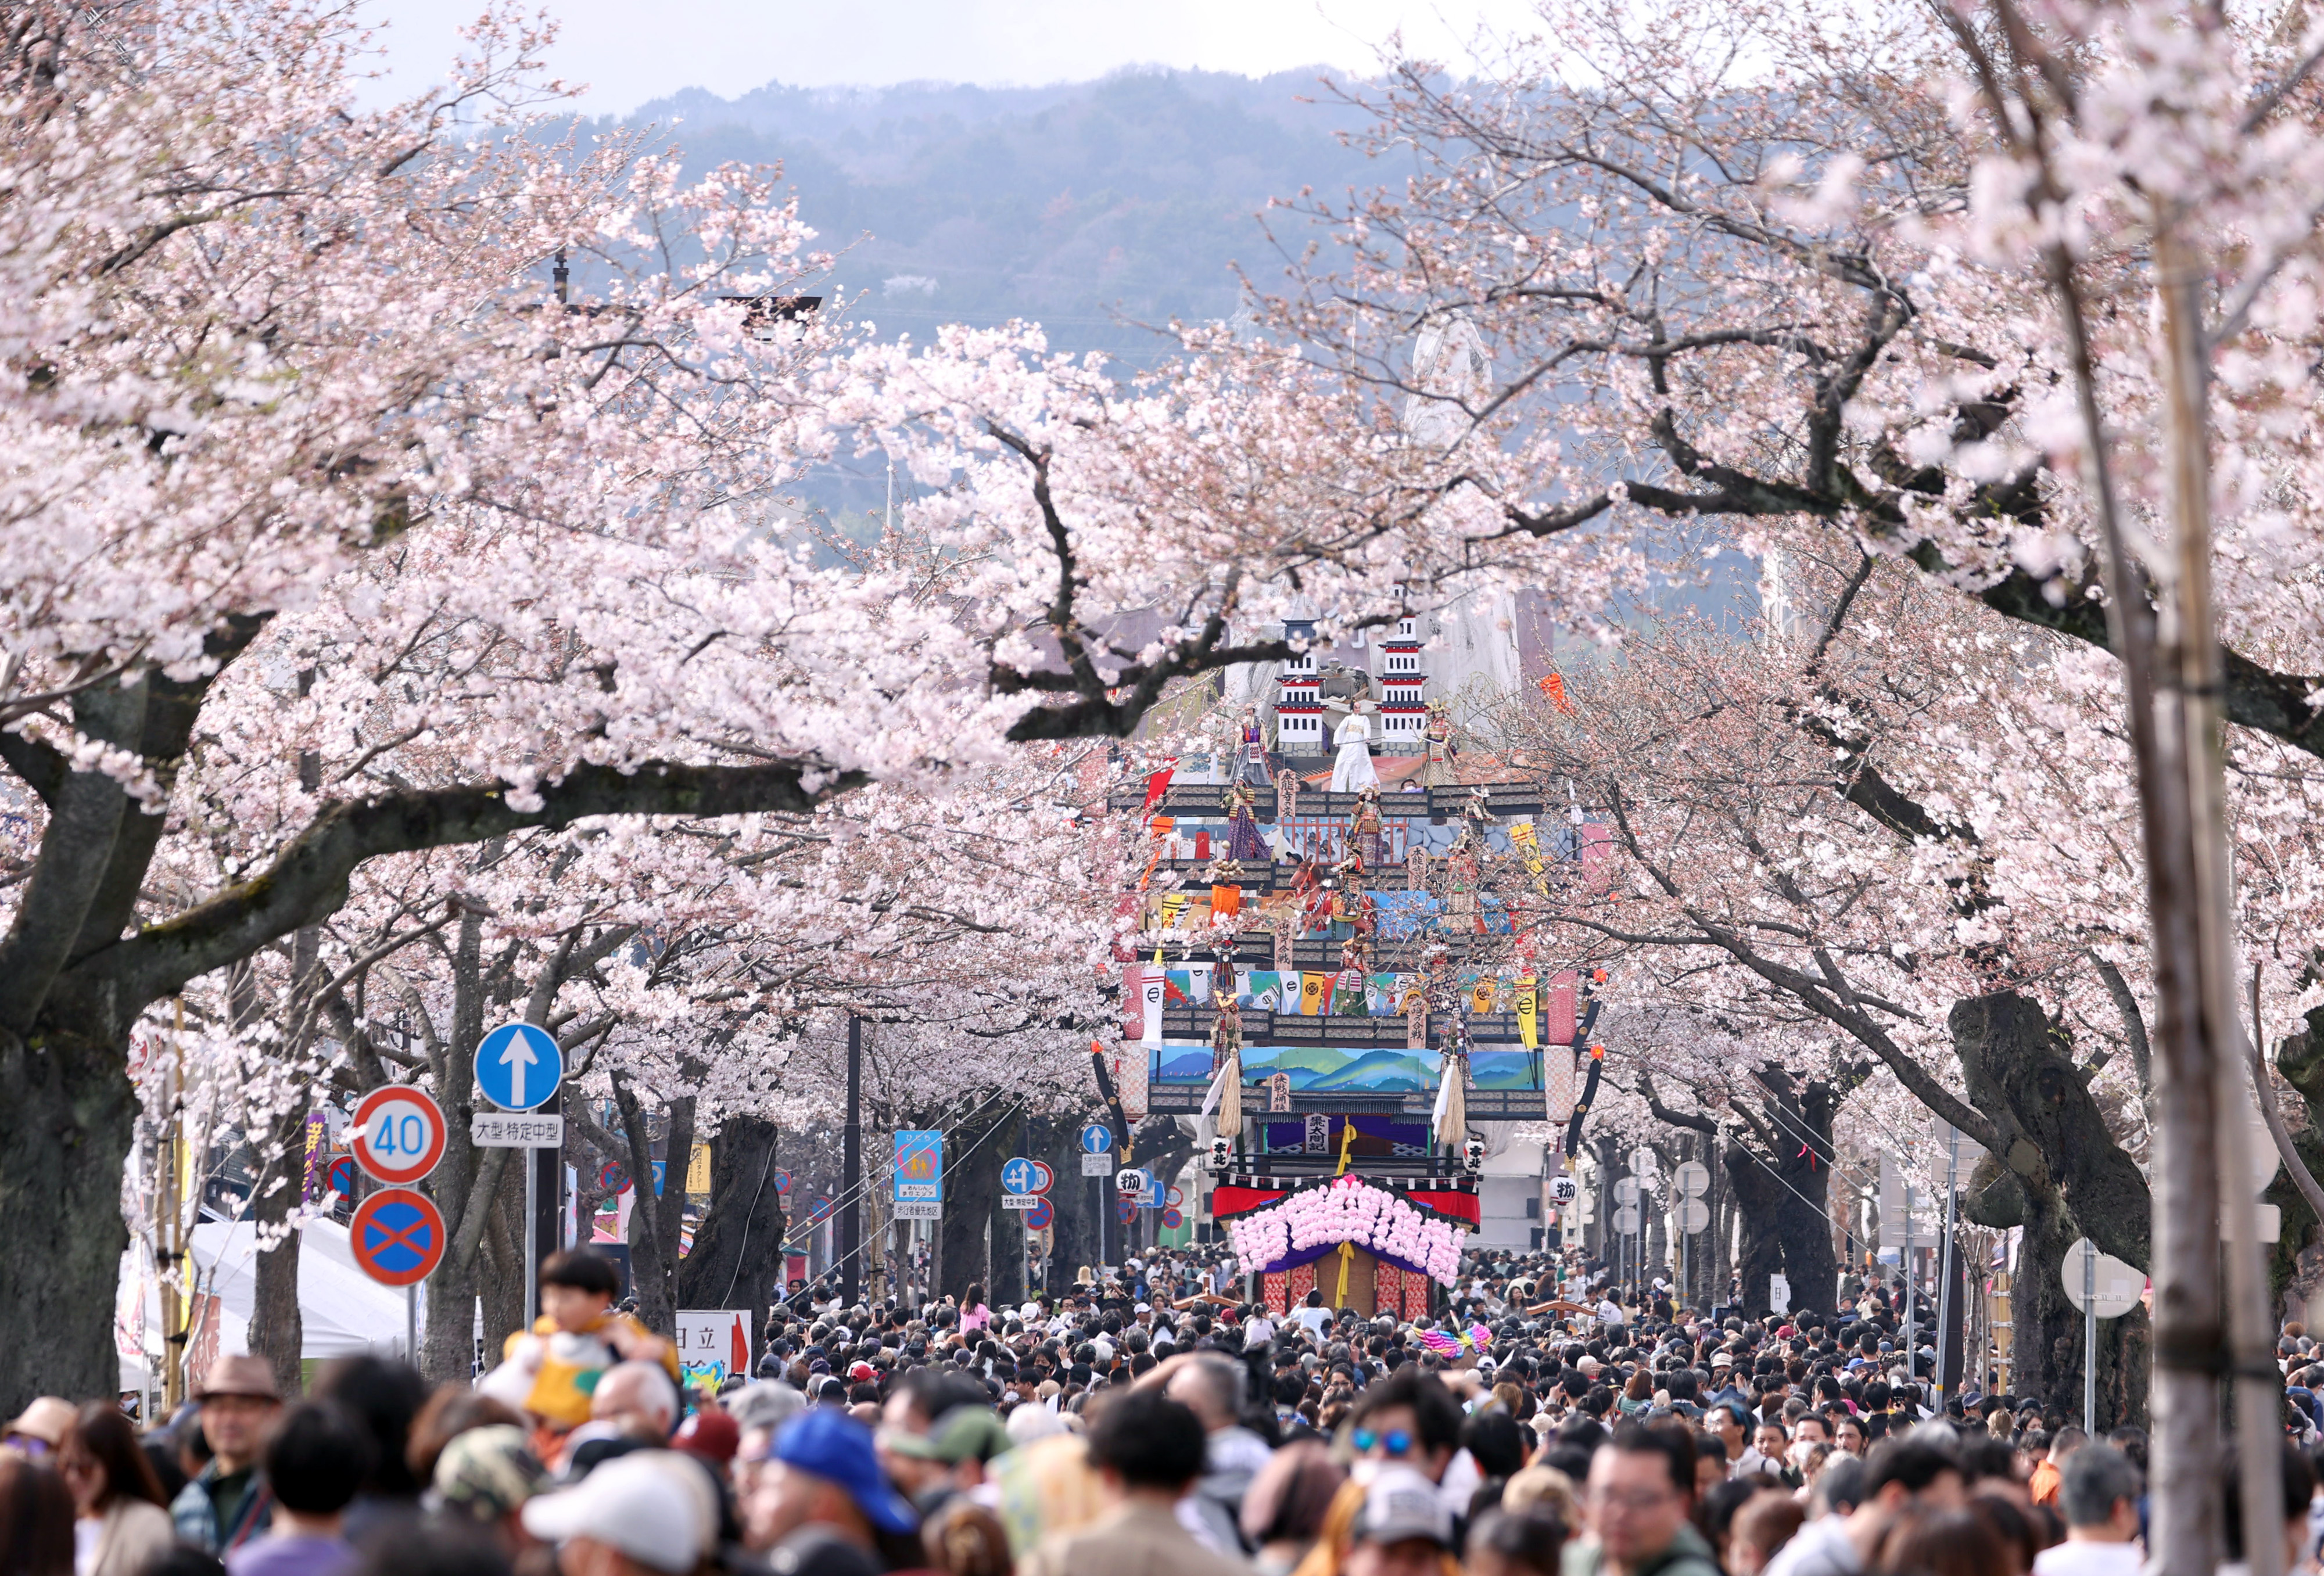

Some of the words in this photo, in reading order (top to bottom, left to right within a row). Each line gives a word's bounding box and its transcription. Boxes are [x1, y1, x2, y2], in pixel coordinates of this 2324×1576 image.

[374, 1115, 423, 1155] 40
[1037, 1171, 1045, 1186] 0
[1121, 1173, 1141, 1190] 物
[1556, 1182, 1576, 1198] 物
